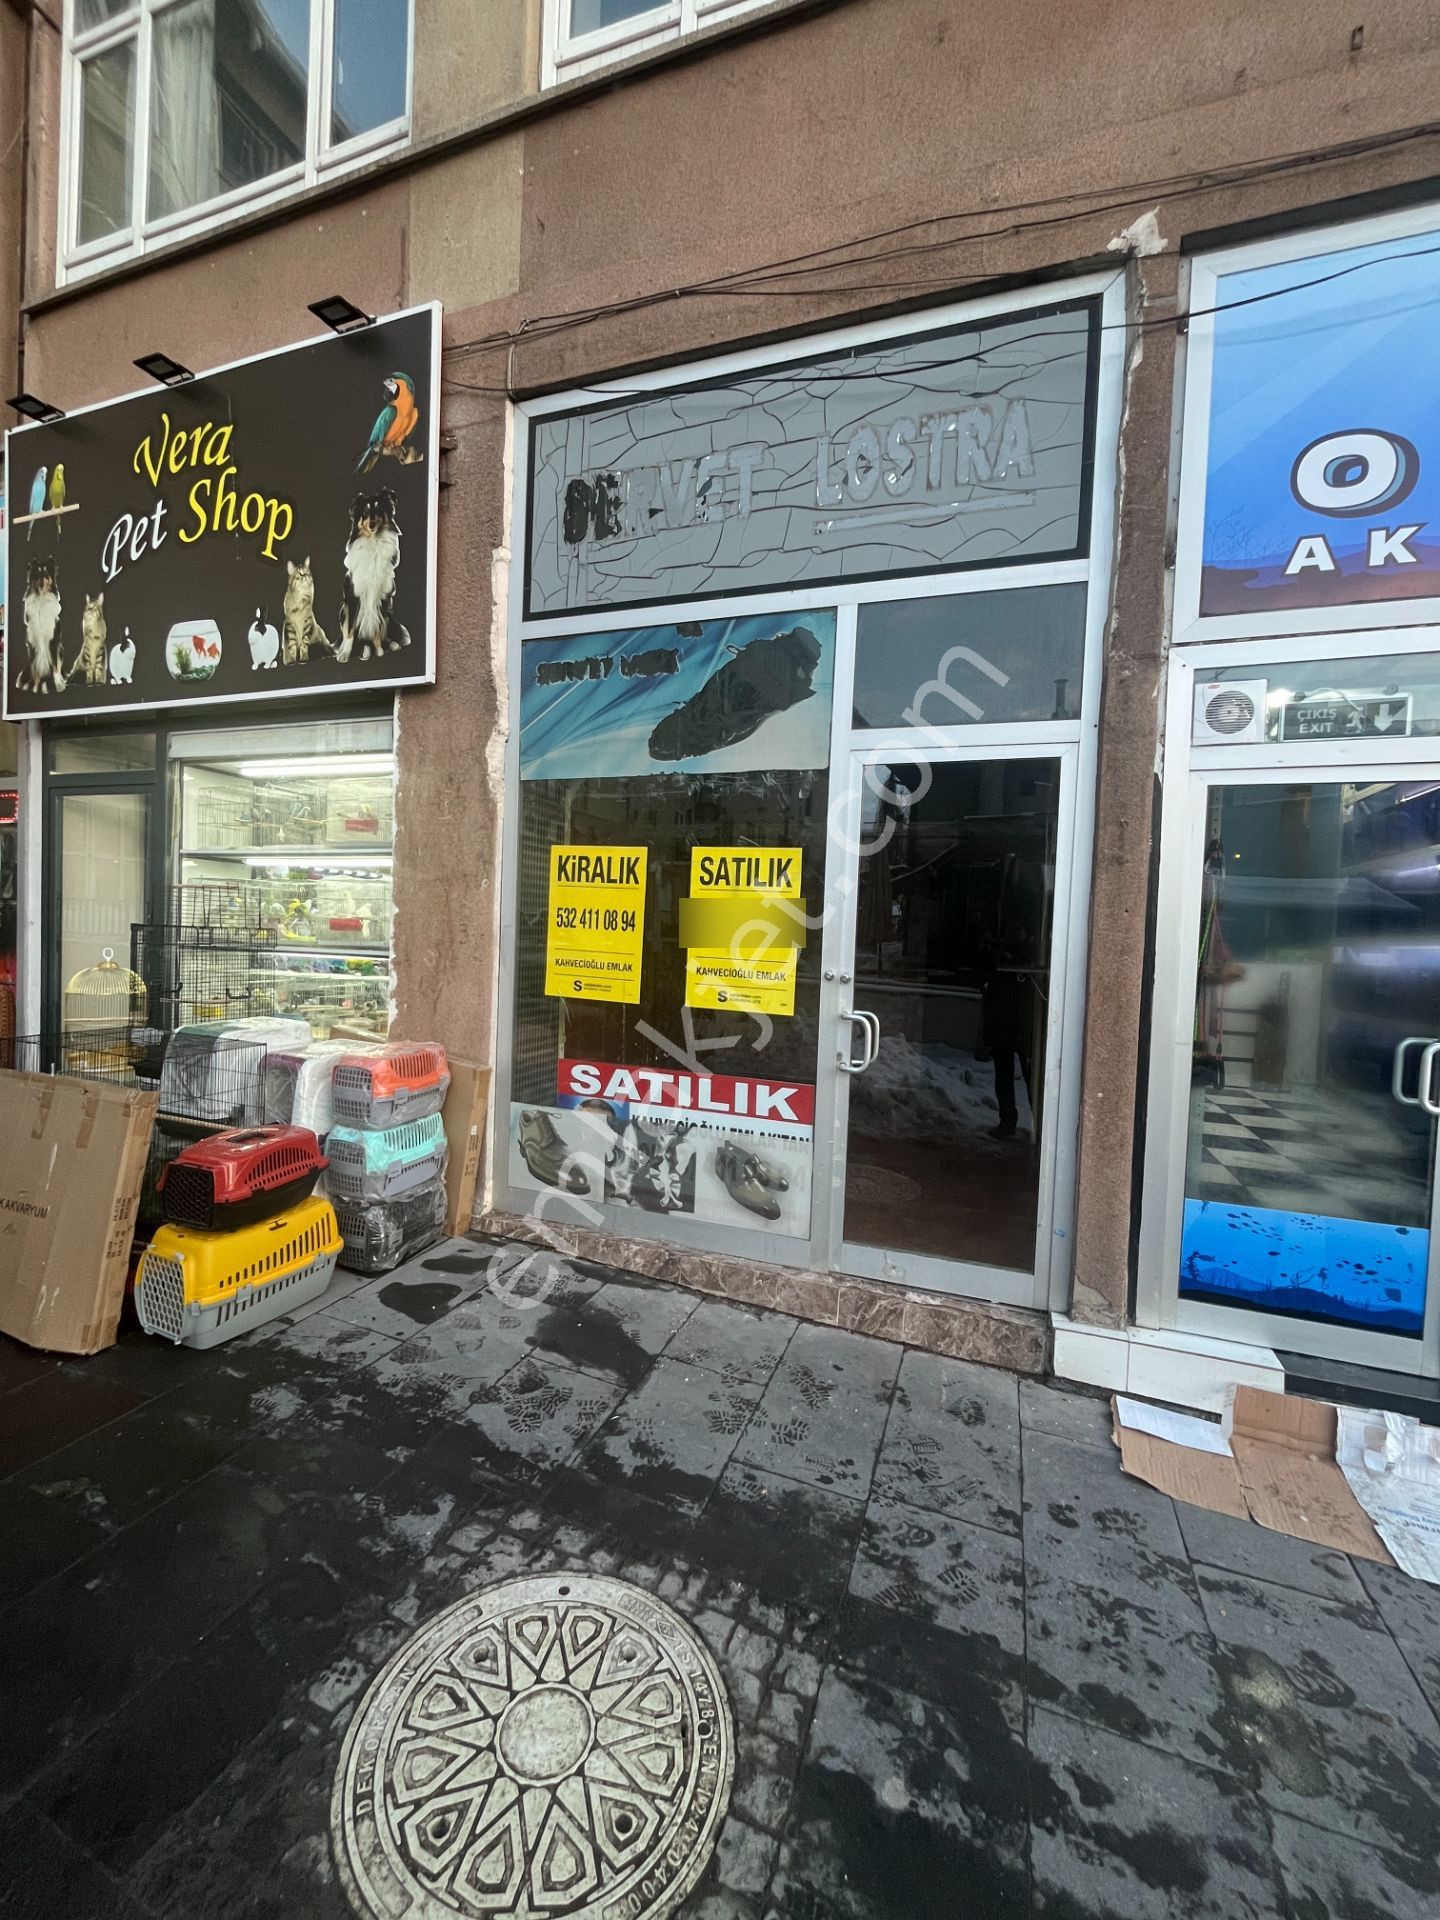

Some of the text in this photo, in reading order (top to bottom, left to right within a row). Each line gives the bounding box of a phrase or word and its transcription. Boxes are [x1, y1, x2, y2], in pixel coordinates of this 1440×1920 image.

[133, 413, 234, 488] Vera
[101, 466, 293, 583] Pet Shop
[1297, 708, 1337, 722] ÇIKIŞ
[1299, 722, 1335, 733] EXIT
[699, 856, 792, 888] SATILIK
[556, 907, 636, 932] 532 411 08 94
[607, 962, 633, 972] EMLAK
[756, 971, 786, 981] EMLAK
[569, 1064, 799, 1120] SATILIK
